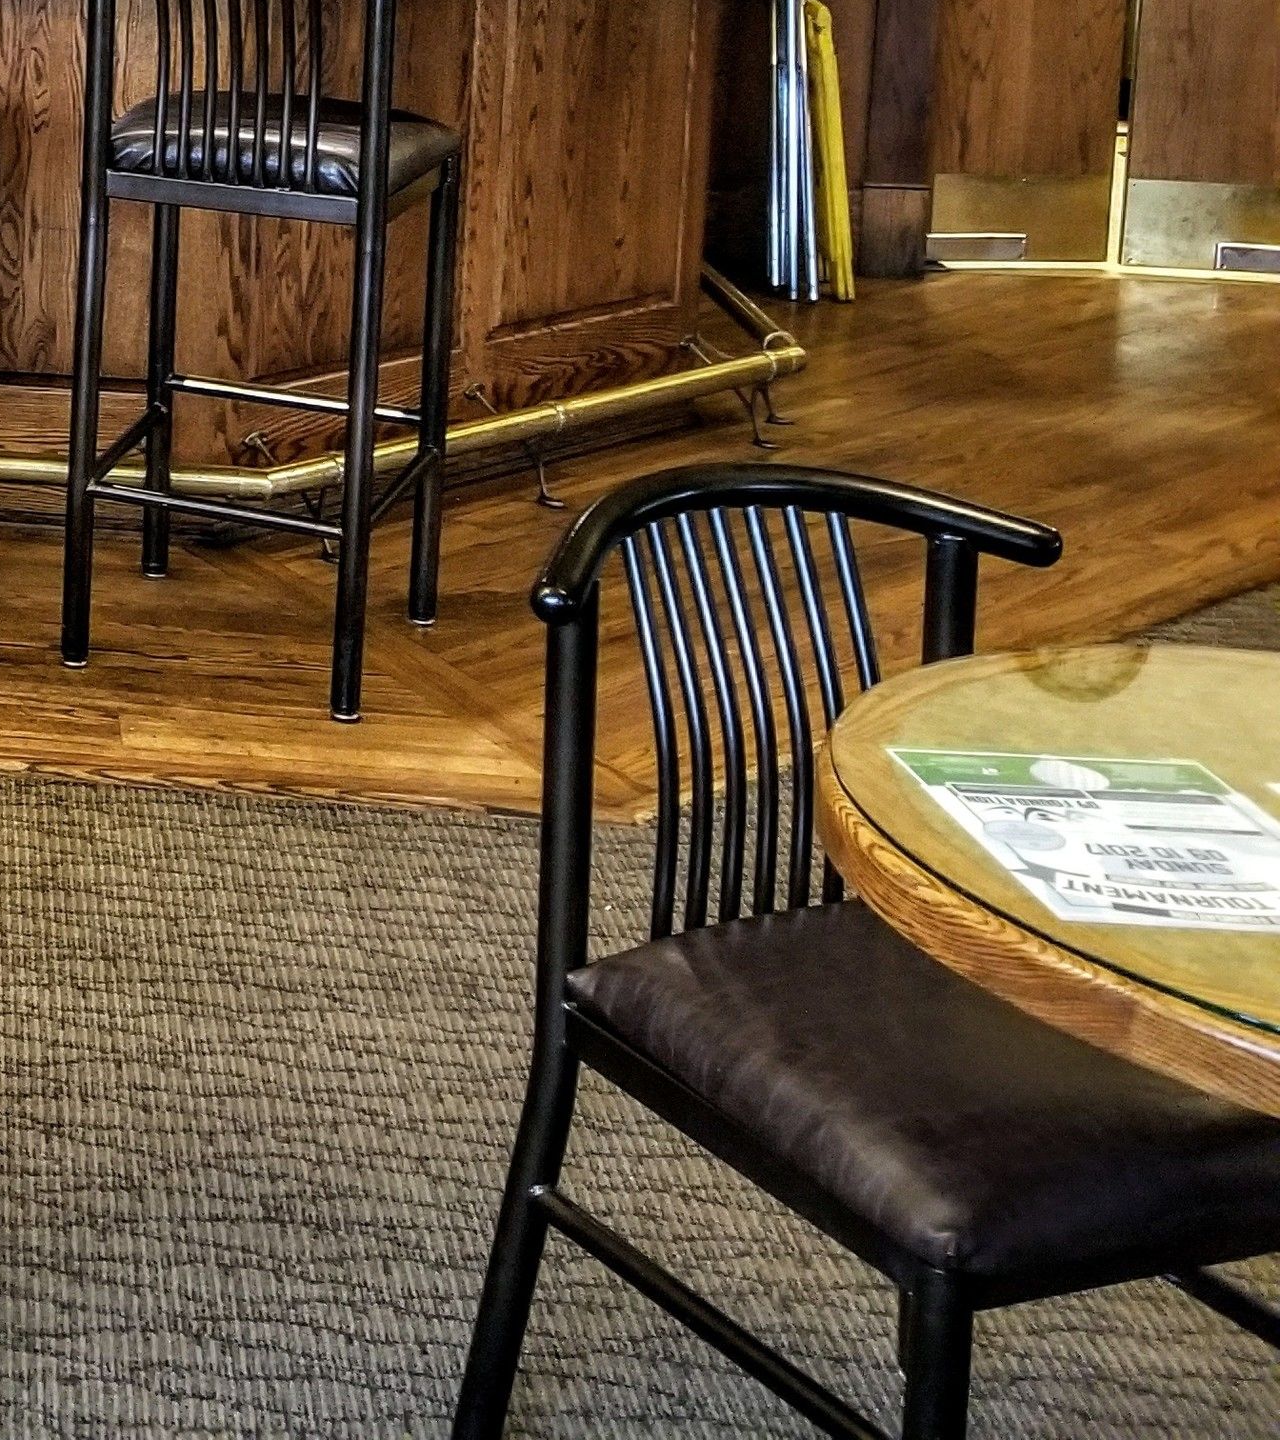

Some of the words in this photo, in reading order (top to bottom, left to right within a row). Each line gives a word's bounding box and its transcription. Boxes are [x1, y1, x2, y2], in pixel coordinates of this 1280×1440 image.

[1085, 842, 1144, 858] 2017
[1152, 845, 1185, 860] 10
[1187, 847, 1230, 863] 09
[1125, 859, 1234, 876] SUNDAY
[1063, 878, 1277, 911] TOURNAMENT
